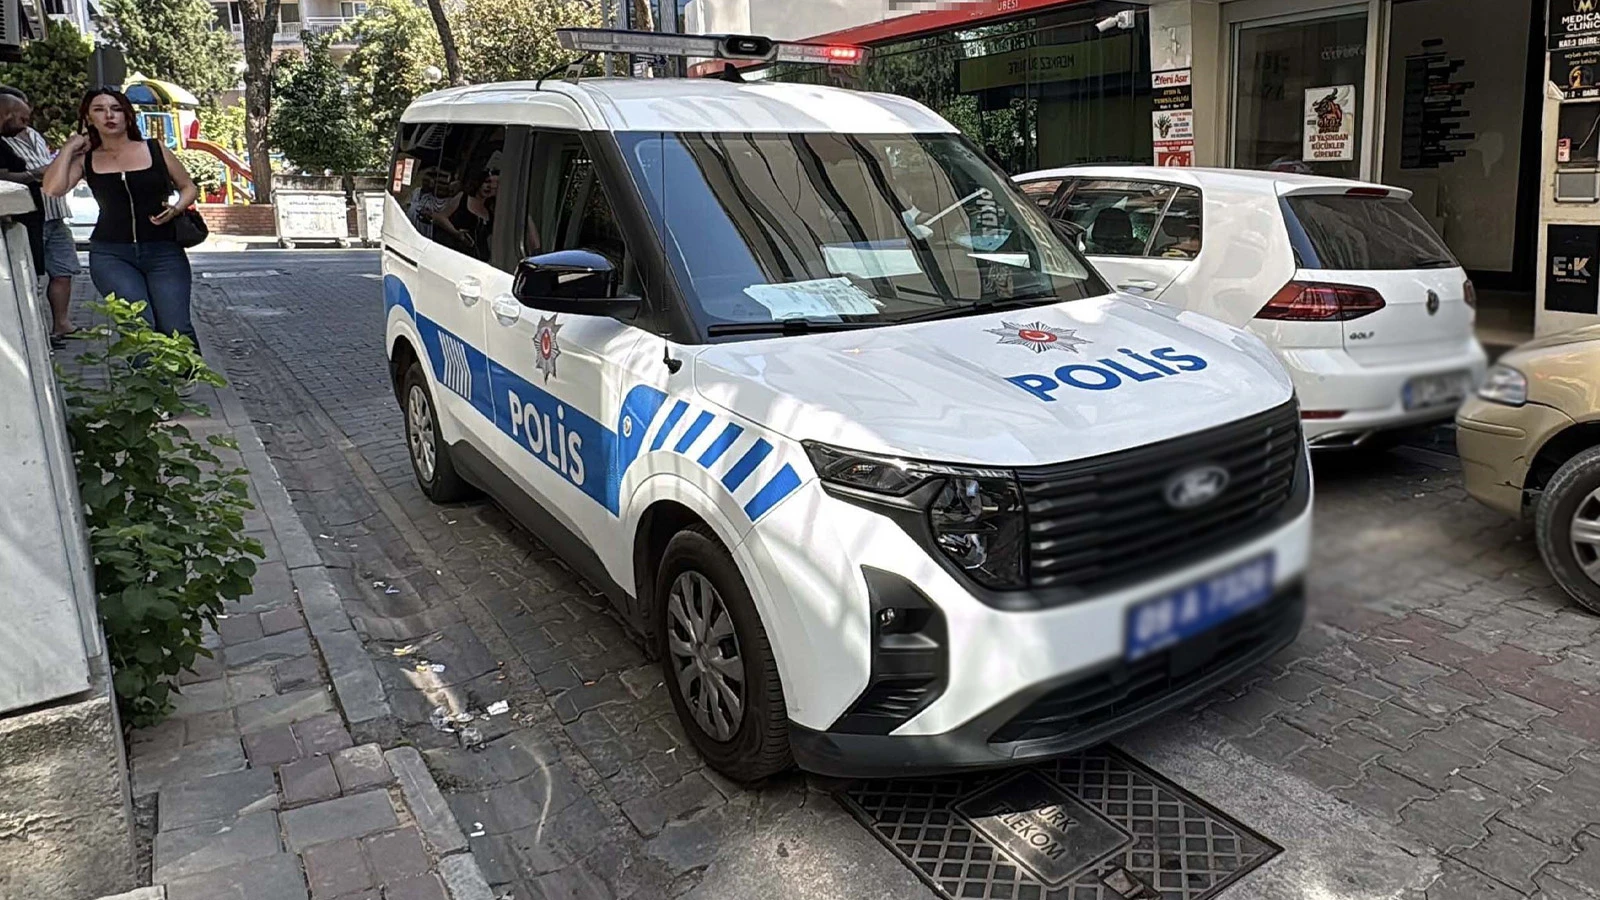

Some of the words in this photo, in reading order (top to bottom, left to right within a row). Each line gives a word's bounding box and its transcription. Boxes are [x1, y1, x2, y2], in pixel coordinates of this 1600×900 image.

[1567, 20, 1600, 31] CLINIC
[1159, 75, 1173, 85] Yeni
[1317, 133, 1349, 142] YAŞINDAN
[1312, 142, 1345, 150] KÜÇÜKLER
[1314, 150, 1342, 158] GİREMEZ
[1349, 331, 1375, 340] GOLF
[1003, 346, 1208, 402] POLİS
[507, 388, 585, 487] POLİS
